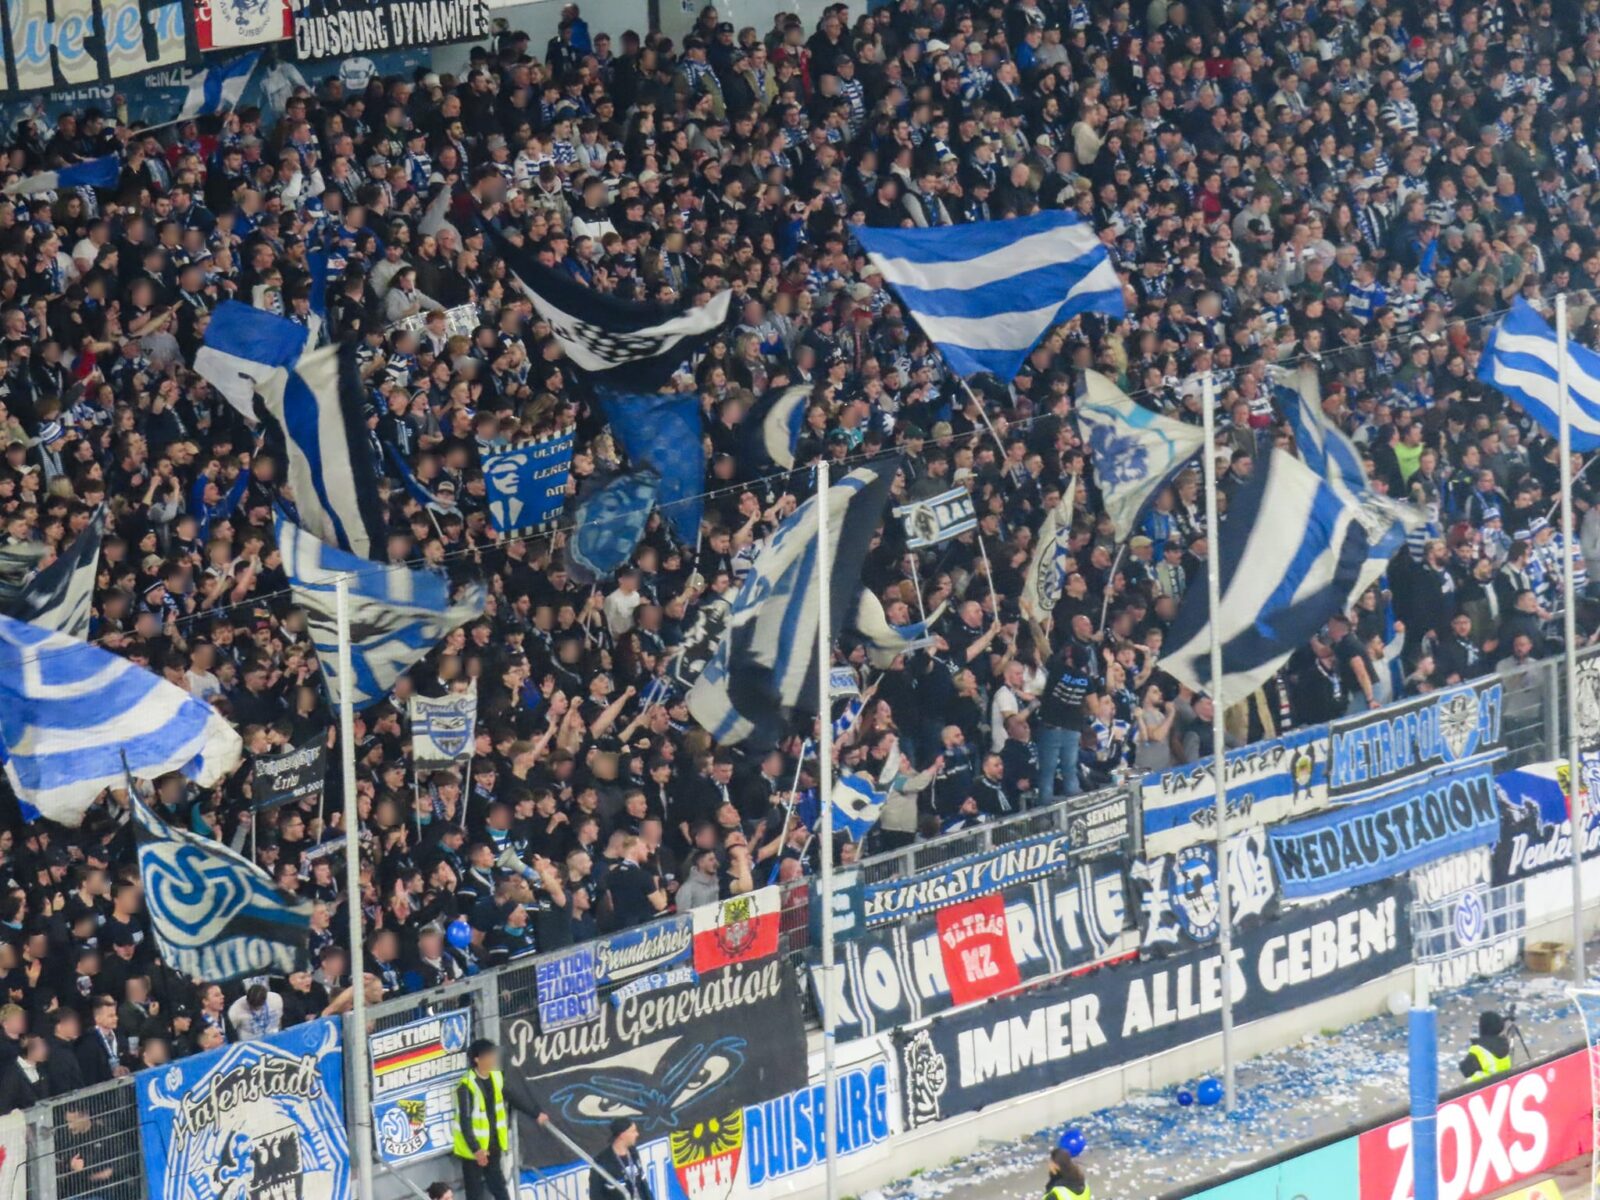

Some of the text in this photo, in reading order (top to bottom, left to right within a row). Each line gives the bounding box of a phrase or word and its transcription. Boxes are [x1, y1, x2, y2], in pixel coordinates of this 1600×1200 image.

[294, 0, 490, 60] DUISBURG DYNAMITES
[1330, 707, 1446, 789] METROPOL
[1272, 775, 1497, 882] WEDAUSTADION
[810, 868, 1125, 1027] KOHRTE
[957, 896, 1397, 1088] IMMER ALLES GEBEN!
[373, 1021, 441, 1056] SEKTION
[508, 960, 783, 1067] Proud Generation
[744, 1062, 891, 1186] DUISBURG
